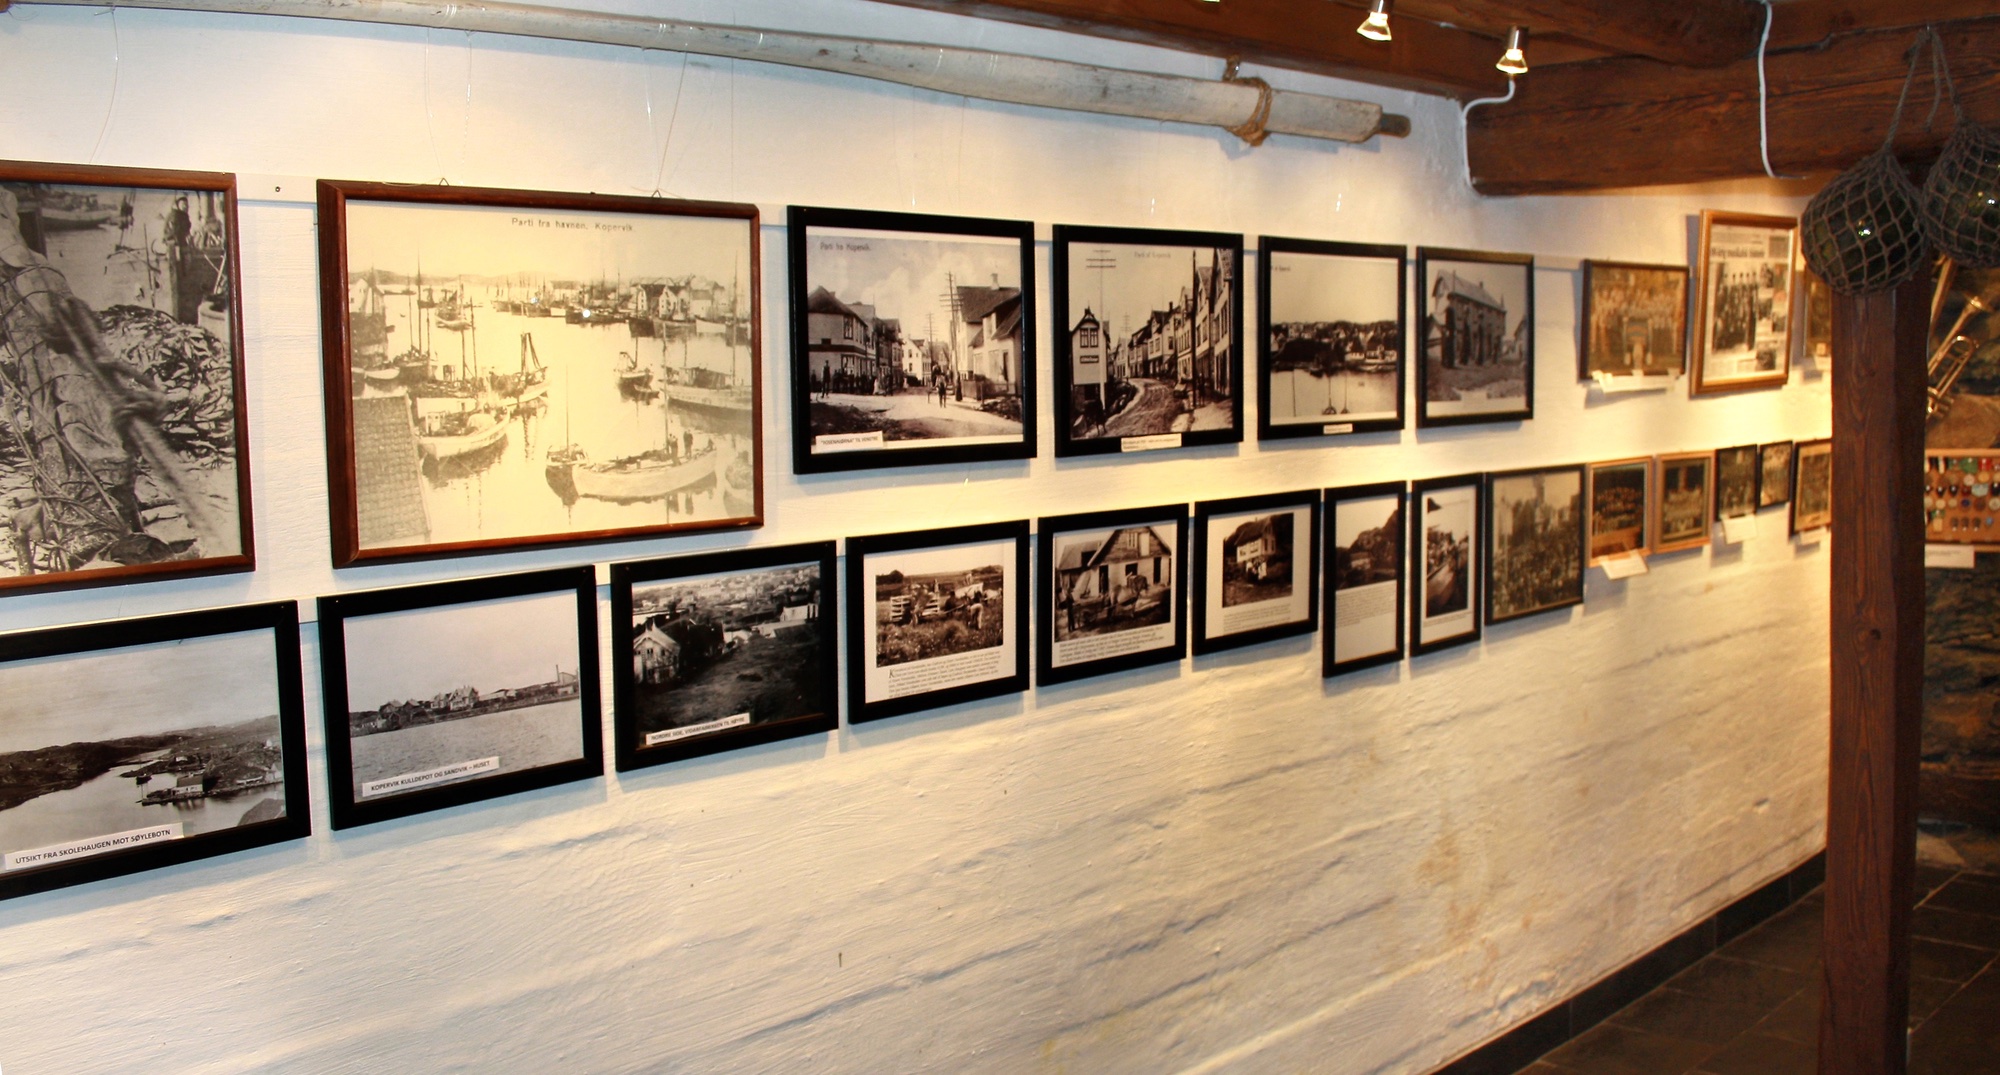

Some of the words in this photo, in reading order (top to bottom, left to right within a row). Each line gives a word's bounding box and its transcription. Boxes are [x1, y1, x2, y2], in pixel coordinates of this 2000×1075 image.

[511, 217, 534, 227] Parti
[538, 219, 551, 228] fra
[594, 222, 633, 233] Kopervik
[371, 780, 400, 791] KOPERVIK
[400, 773, 433, 785] KULLDEPOT
[443, 766, 468, 777] SANDVIK
[473, 760, 490, 770] HUSET
[15, 853, 42, 864] UTSIKT
[43, 851, 58, 860] FRA
[59, 840, 111, 857] SKOLEHAUGEN
[112, 836, 129, 846] MOT
[130, 829, 171, 843] SØYLEBOTN
